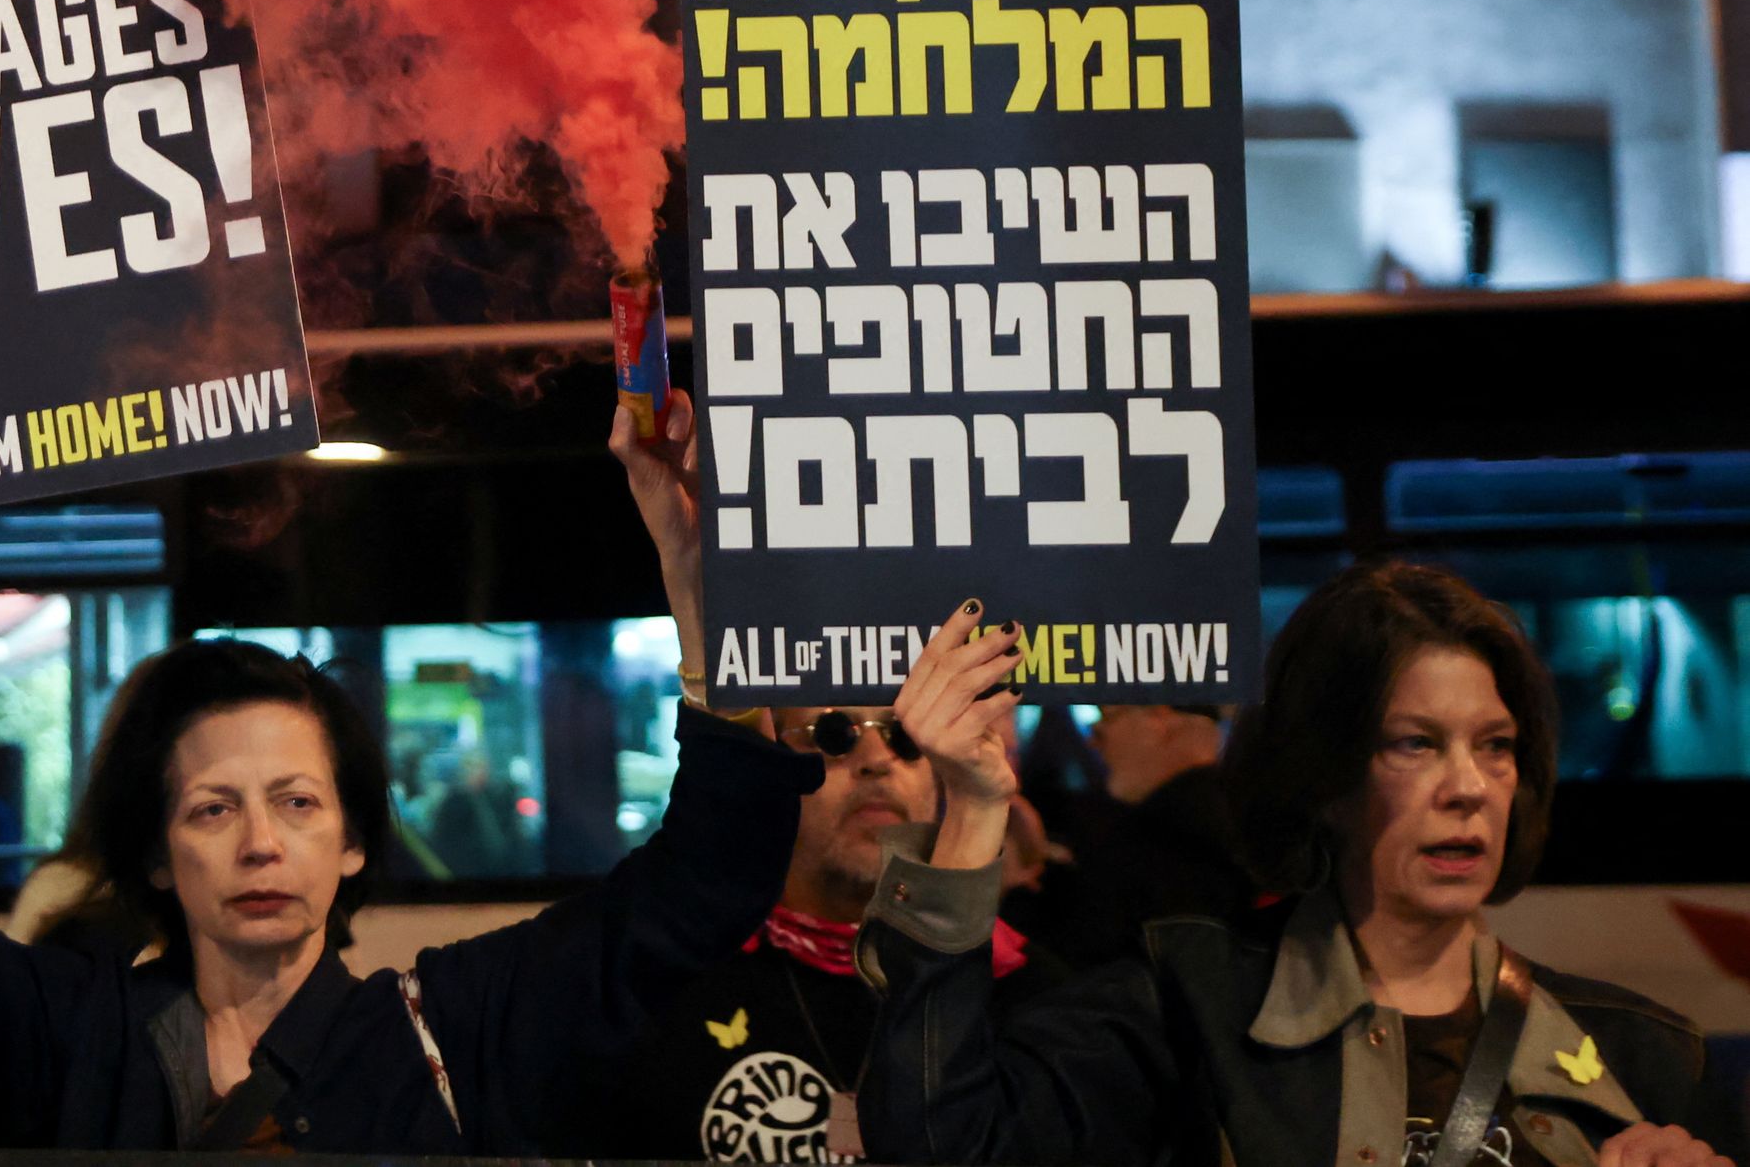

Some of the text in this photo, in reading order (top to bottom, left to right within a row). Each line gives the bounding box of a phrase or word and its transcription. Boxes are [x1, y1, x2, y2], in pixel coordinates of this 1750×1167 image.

[702, 162, 1217, 273] השיבו את
[702, 278, 1221, 396] החטופים
[27, 388, 166, 472] HOME!
[172, 368, 293, 444] NOW!
[708, 398, 1225, 549] לביתם!
[715, 627, 800, 687] ALL
[795, 640, 823, 674] OF
[1105, 622, 1229, 684] NOW!
